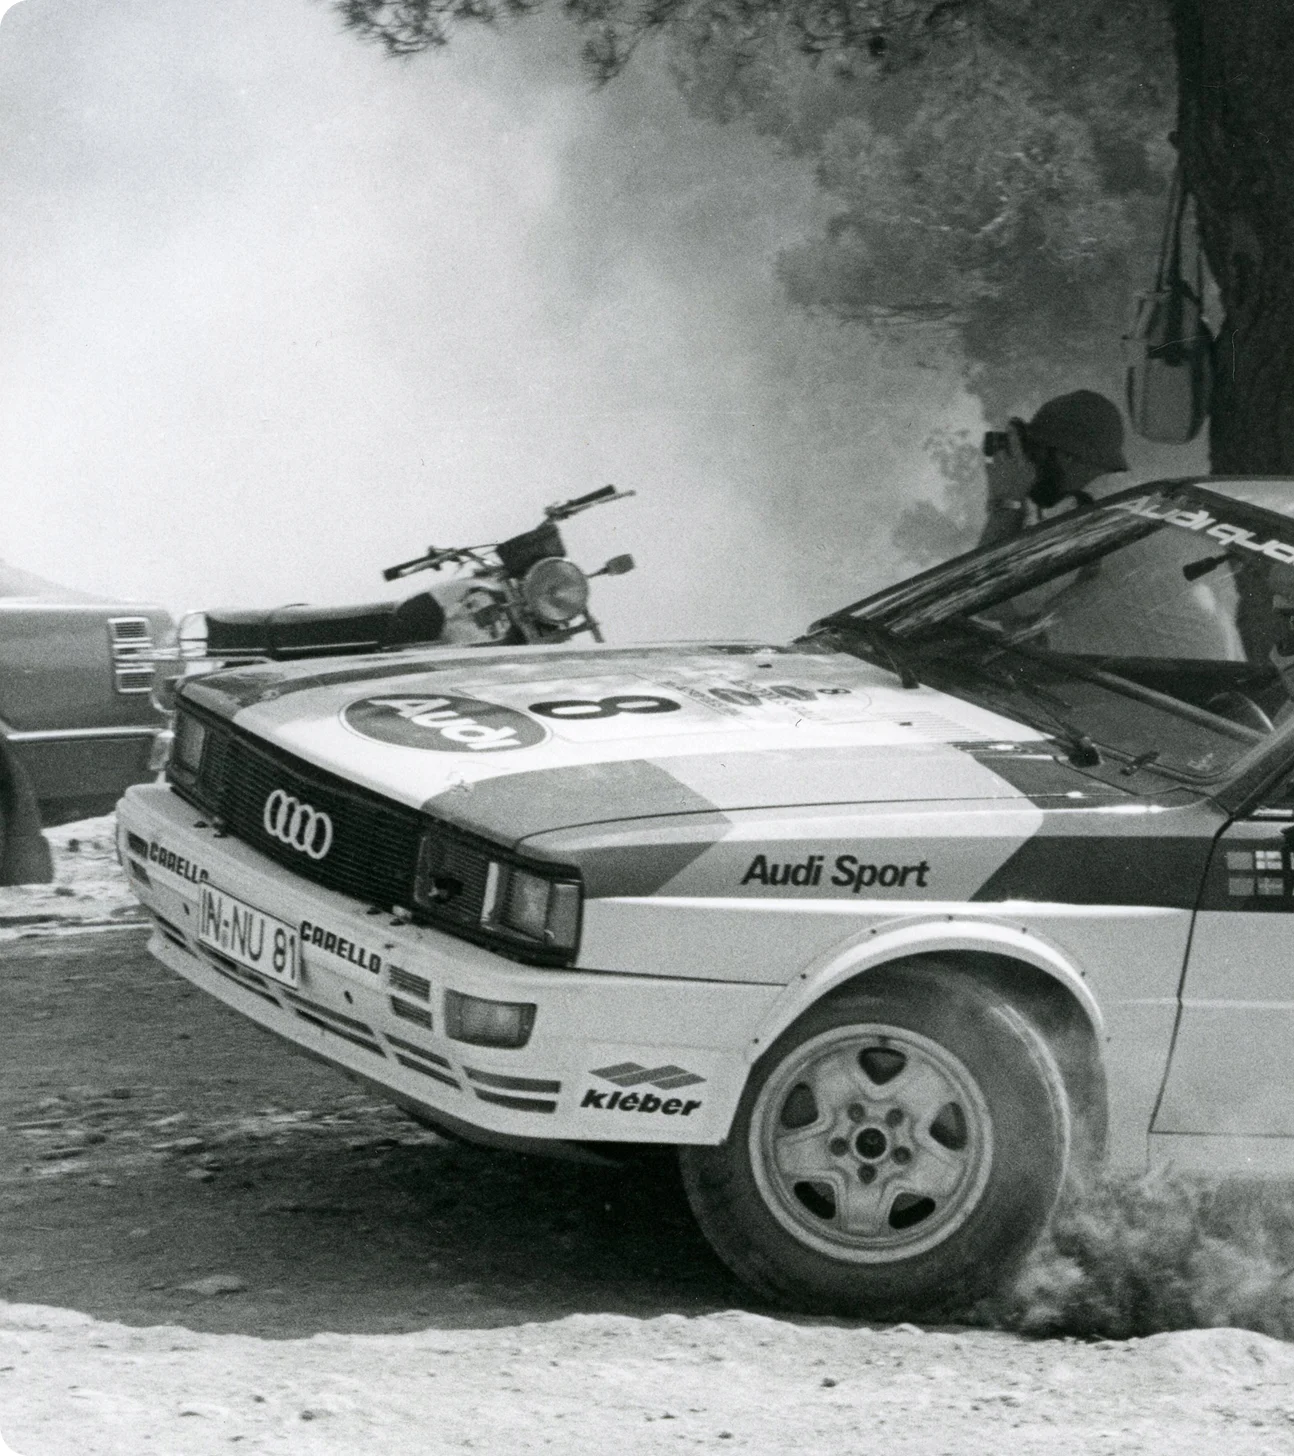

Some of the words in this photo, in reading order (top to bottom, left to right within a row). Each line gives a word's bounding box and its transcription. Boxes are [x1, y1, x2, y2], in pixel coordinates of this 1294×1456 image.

[1104, 495, 1216, 531] Audi
[368, 697, 522, 751] Audi
[528, 695, 682, 720] 8
[150, 842, 209, 884] CARELLO
[740, 855, 823, 887] Audi
[830, 854, 931, 893] Sport
[273, 927, 296, 980] 81
[300, 920, 382, 976] CARELLO
[580, 1089, 703, 1118] kléber
